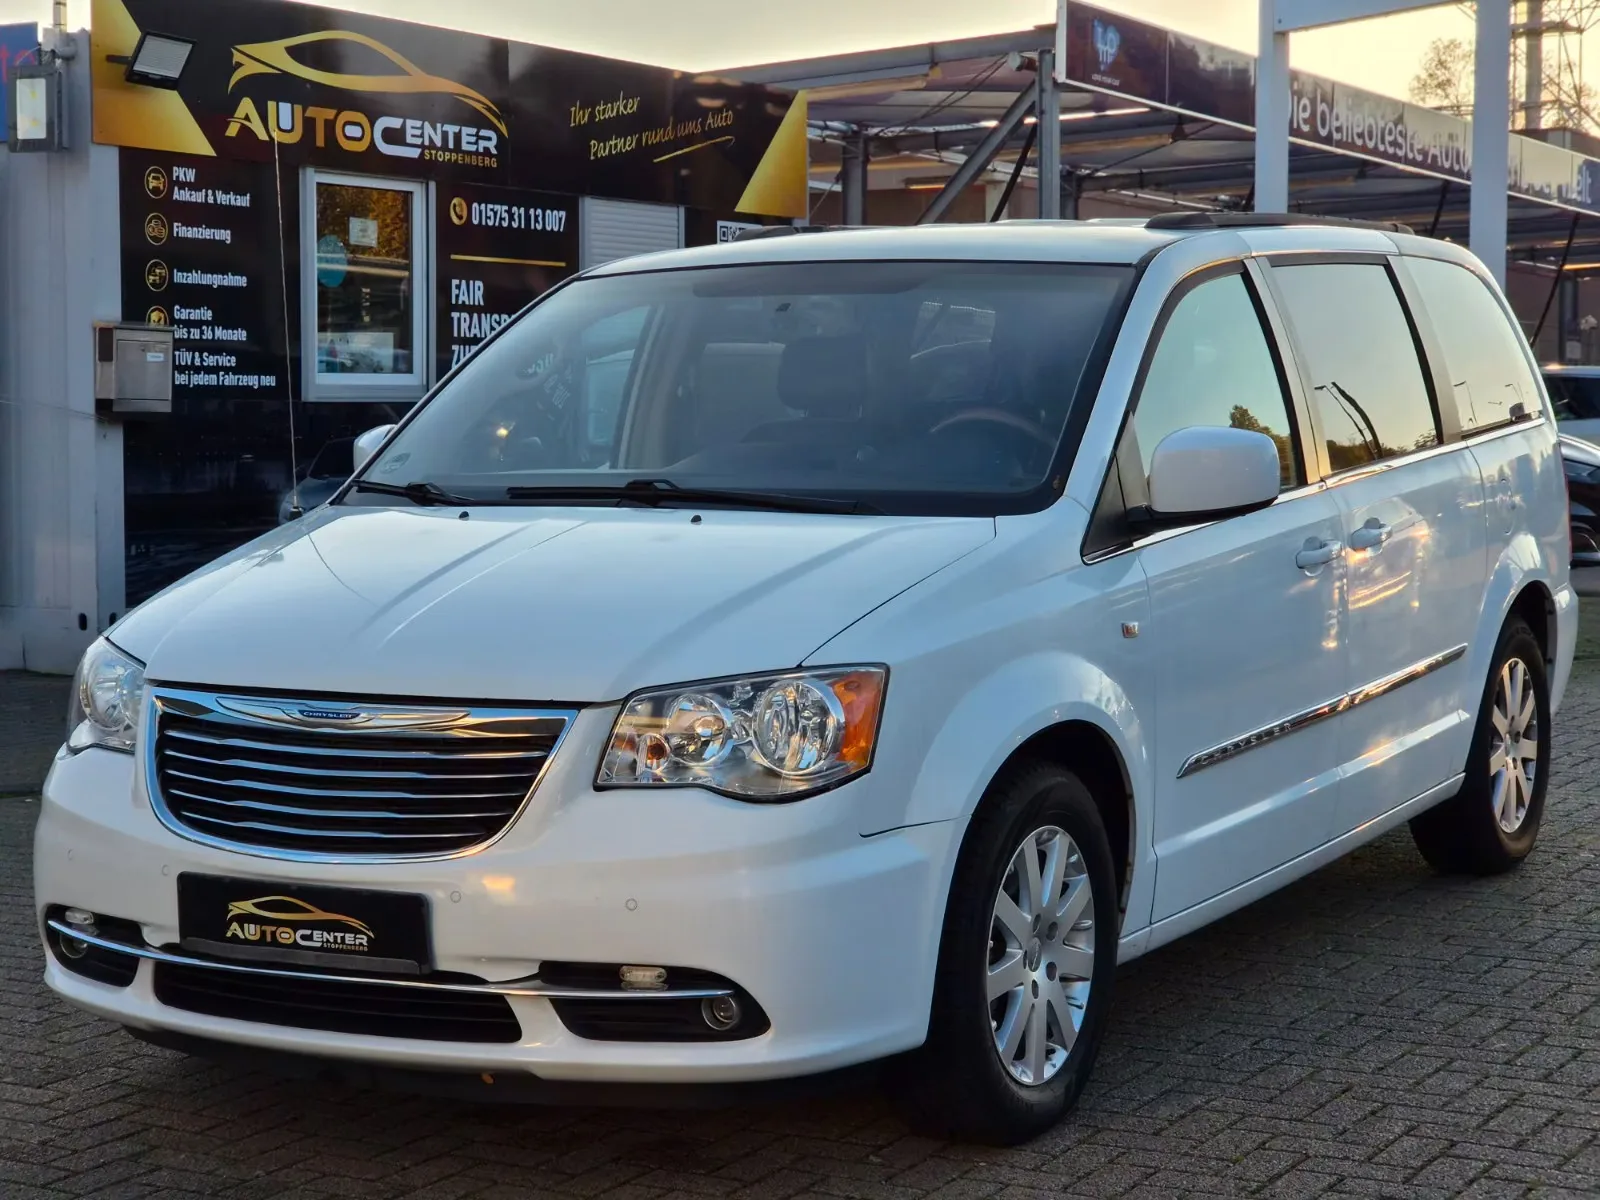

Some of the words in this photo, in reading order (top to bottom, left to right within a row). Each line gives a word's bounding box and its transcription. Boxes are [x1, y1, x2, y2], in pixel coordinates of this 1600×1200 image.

[570, 101, 591, 127] Ihr
[595, 90, 641, 122] starker
[1289, 82, 1311, 132] ie
[1316, 87, 1423, 162] beliebteste
[590, 133, 639, 160] Partner
[642, 116, 676, 147] rund
[677, 117, 702, 138] ums
[704, 108, 734, 131] Auto
[424, 150, 498, 168] STOPPENBERG
[172, 166, 196, 183] PKW
[172, 186, 206, 203] Ankauf
[207, 189, 215, 204] &
[216, 190, 251, 207] Verkauf
[471, 202, 509, 228] 01575
[511, 206, 525, 229] 31
[529, 207, 543, 231] 13
[545, 209, 566, 232] 007
[173, 222, 232, 244] Finanzierung
[173, 268, 248, 288] Inzahlungnahme
[451, 278, 485, 306] FAIR
[173, 305, 213, 320] Garantie
[174, 325, 188, 339] bis
[190, 327, 200, 339] zu
[202, 325, 213, 340] 36
[214, 325, 248, 341] Monate
[174, 348, 193, 366] TÜV
[194, 351, 201, 366] &
[202, 352, 237, 367] Service
[174, 371, 189, 385] bei
[189, 371, 218, 388] jedem
[219, 371, 259, 389] Fahrzeug
[260, 375, 276, 387] neu
[303, 711, 354, 719] CHRYSLER
